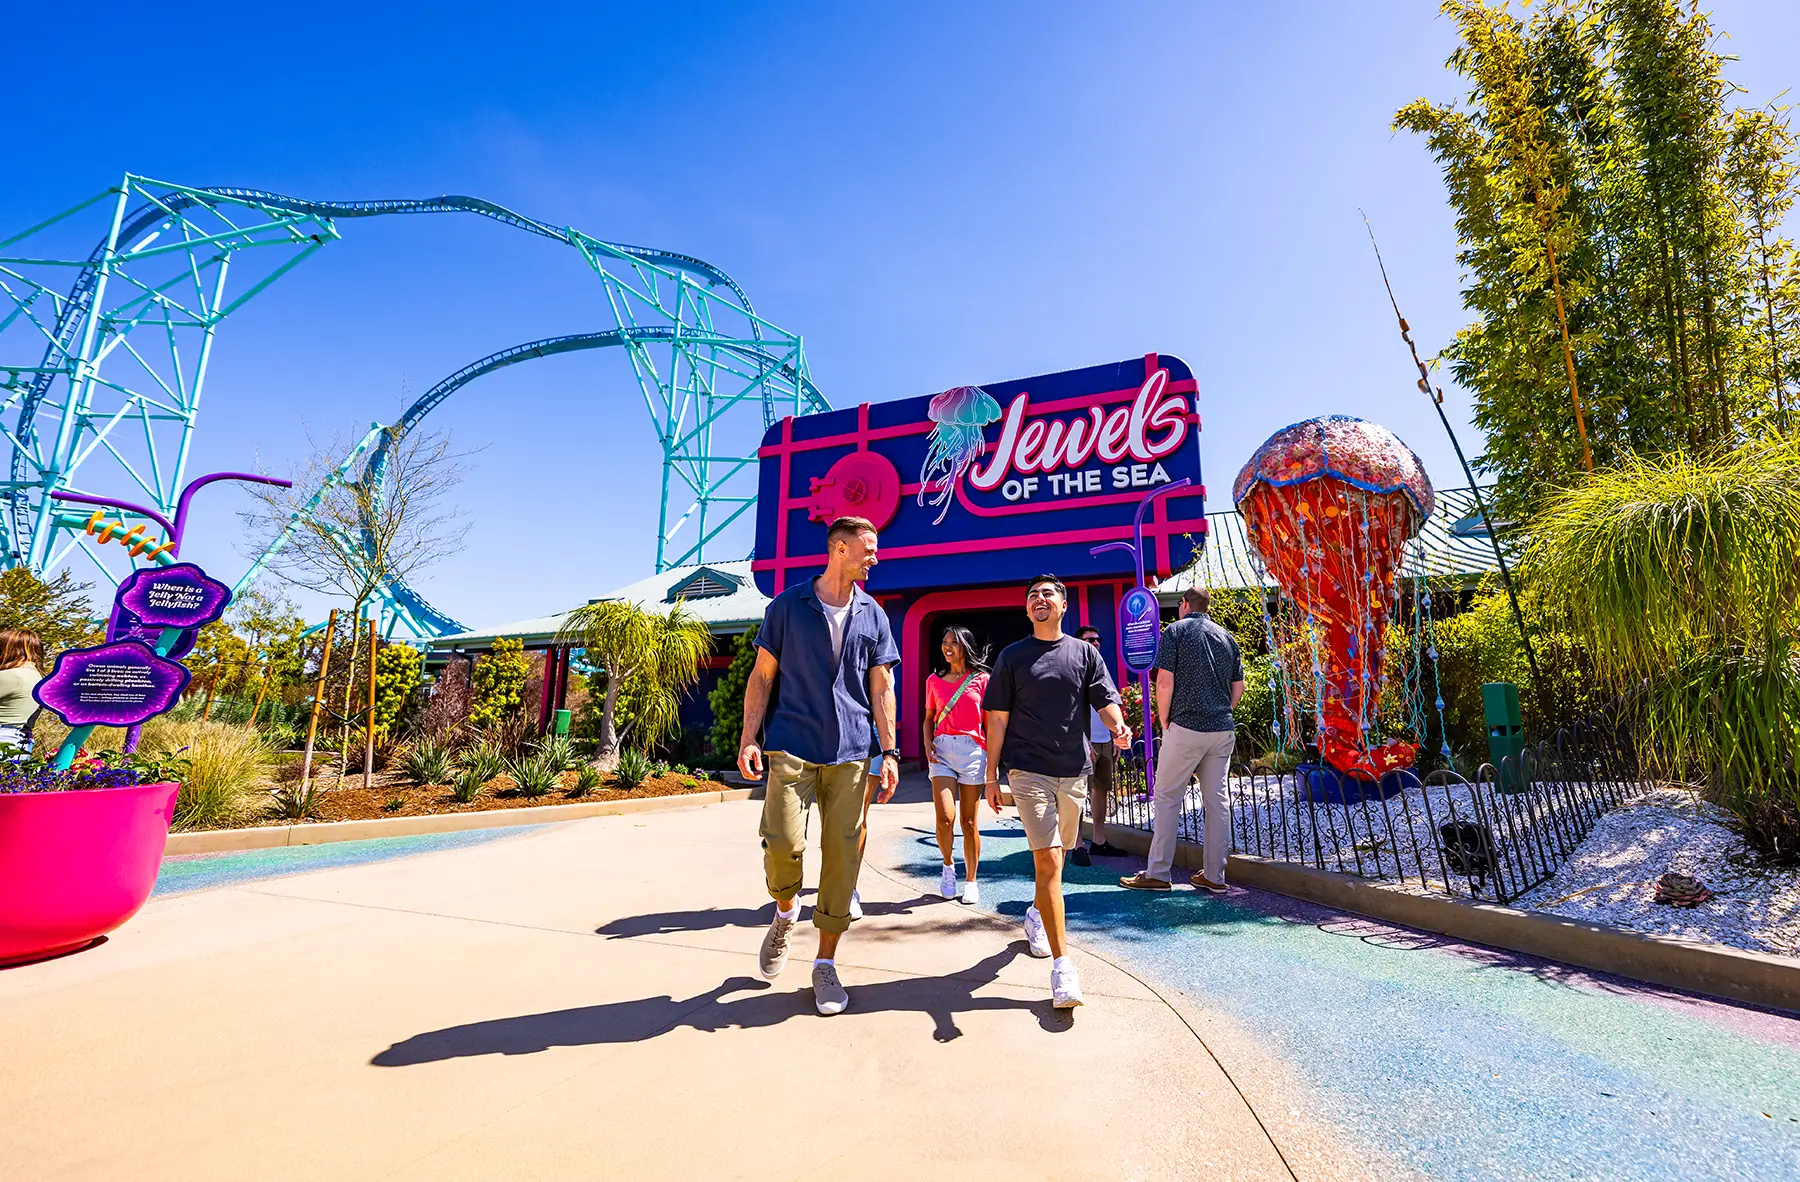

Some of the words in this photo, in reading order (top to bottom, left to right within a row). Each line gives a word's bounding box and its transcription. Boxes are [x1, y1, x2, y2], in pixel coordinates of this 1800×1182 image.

[969, 369, 1188, 489] Jewels
[1002, 477, 1039, 501] OF
[1048, 469, 1102, 495] THE
[1112, 462, 1171, 488] SEA
[153, 583, 184, 591] When
[148, 590, 174, 600] Jelly
[175, 592, 196, 601] Not
[149, 600, 200, 609] Jellyfish?
